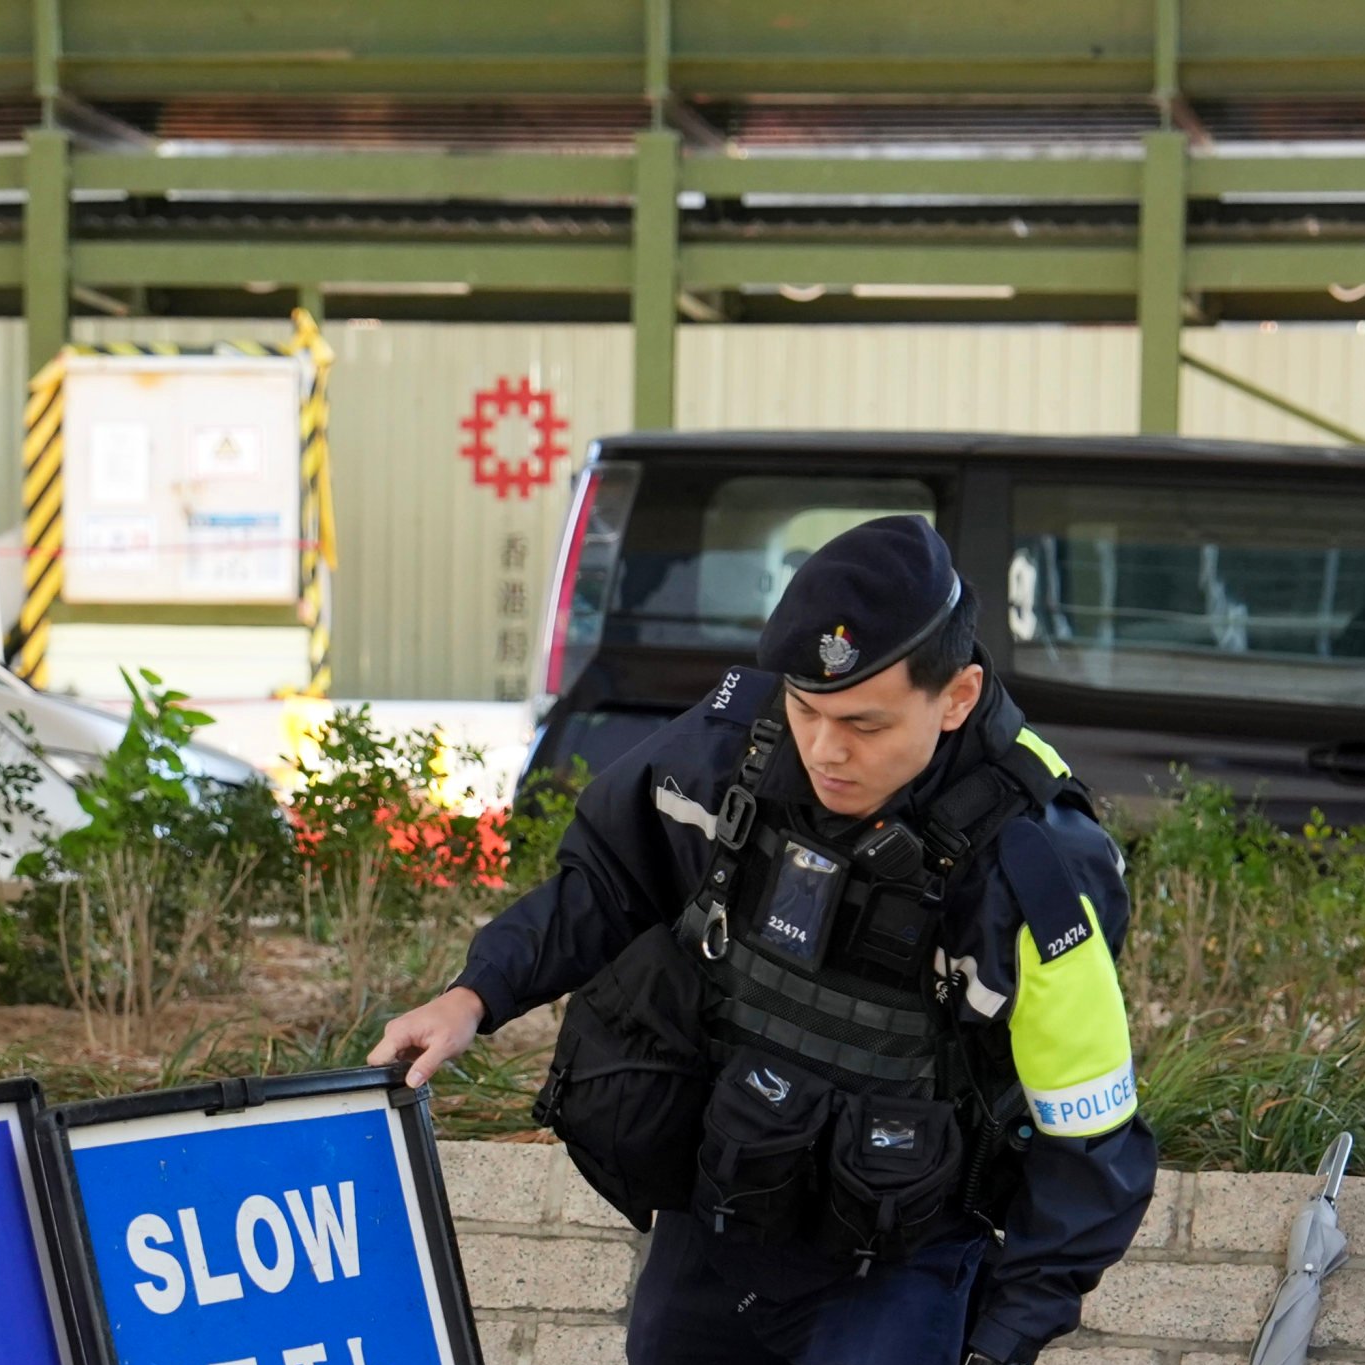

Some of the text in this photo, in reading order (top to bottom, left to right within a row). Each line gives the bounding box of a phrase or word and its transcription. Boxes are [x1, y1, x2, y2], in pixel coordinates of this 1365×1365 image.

[711, 672, 741, 709] 22474
[768, 915, 807, 943] 22474
[1047, 923, 1087, 957] 22474
[126, 1180, 361, 1315] SLOW
[737, 1291, 757, 1312] HKP
